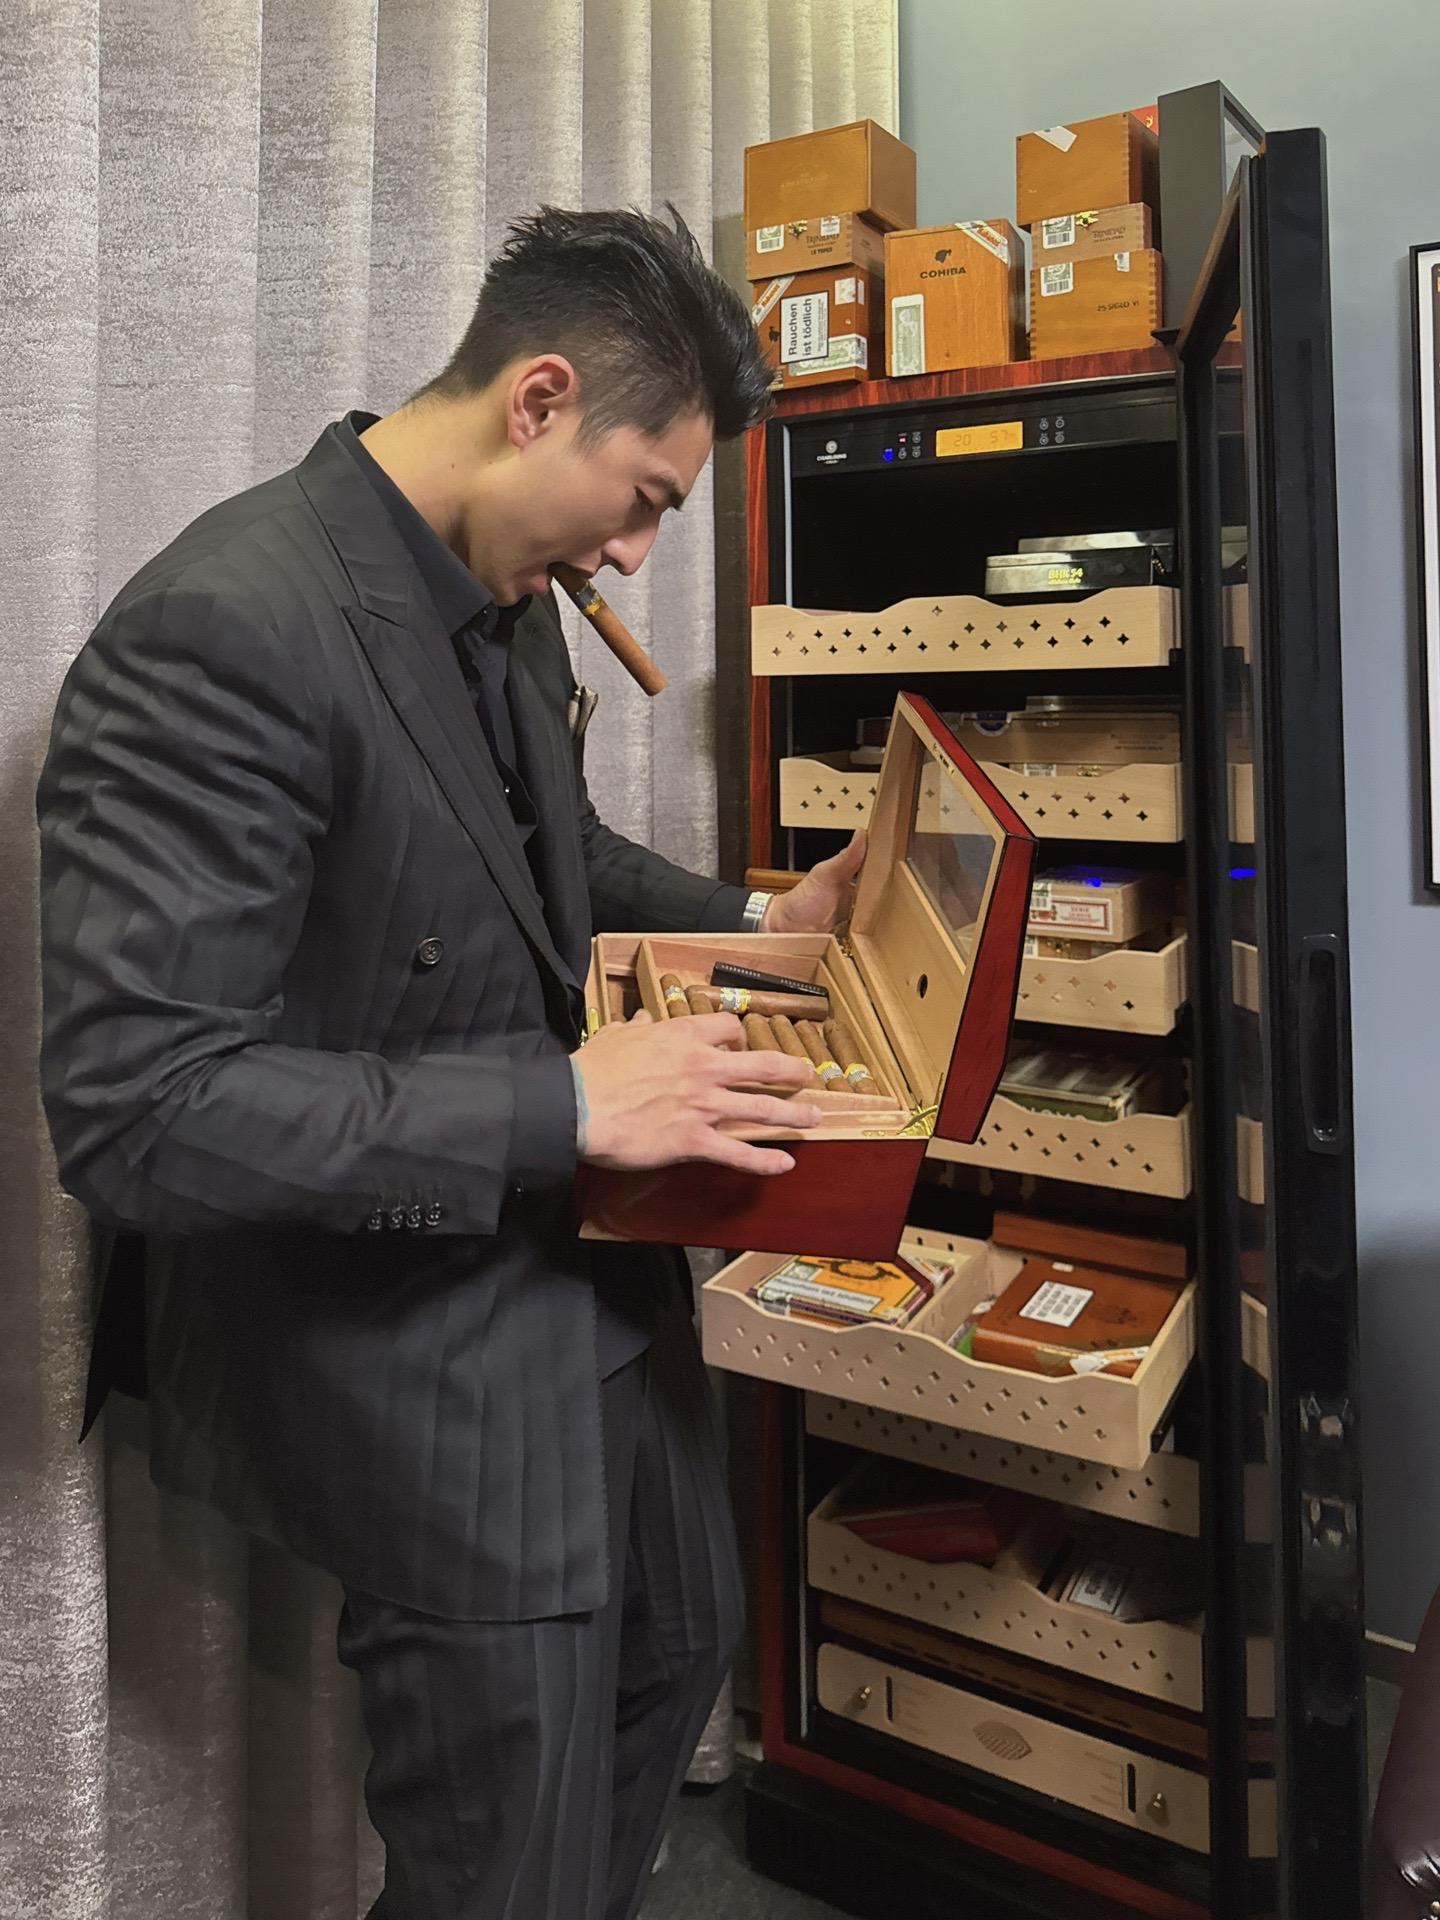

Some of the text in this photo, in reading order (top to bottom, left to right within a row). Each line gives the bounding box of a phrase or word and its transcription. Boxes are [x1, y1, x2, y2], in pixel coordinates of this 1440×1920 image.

[920, 266, 967, 279] COHIBA
[788, 303, 798, 356] Rauchen
[802, 298, 812, 356] ist tödlich
